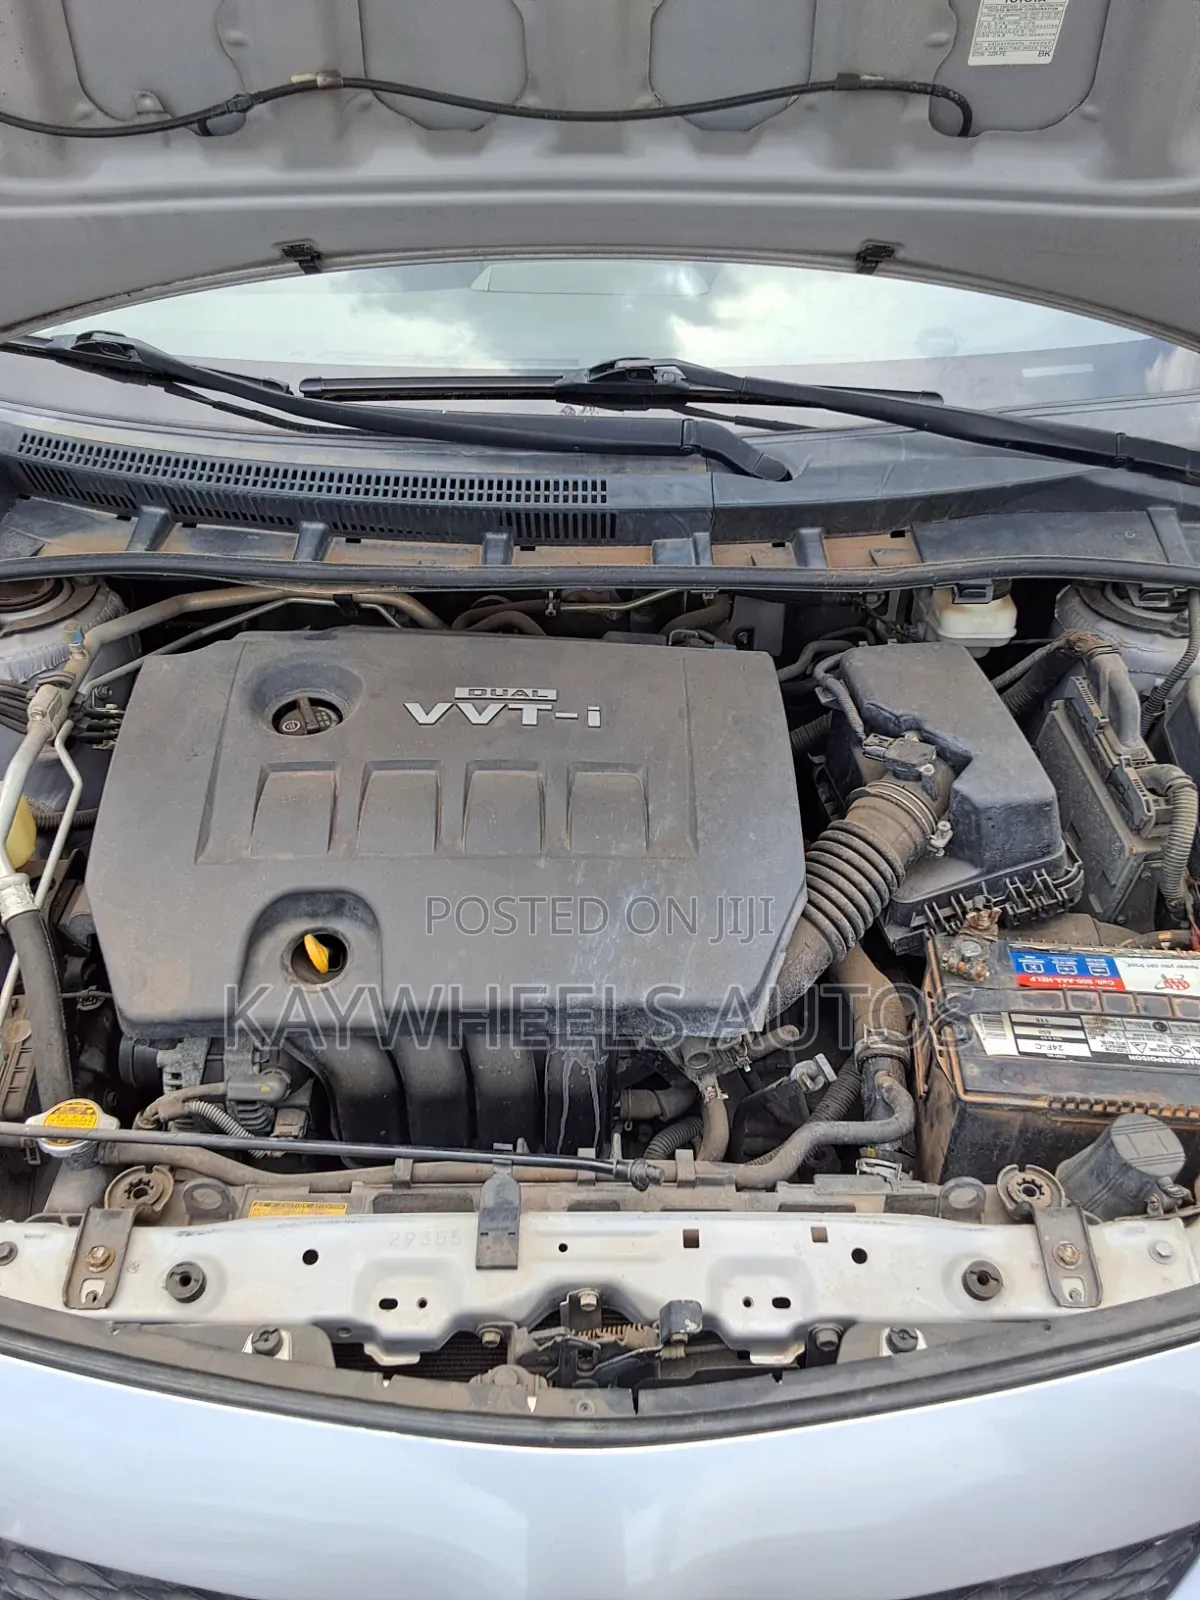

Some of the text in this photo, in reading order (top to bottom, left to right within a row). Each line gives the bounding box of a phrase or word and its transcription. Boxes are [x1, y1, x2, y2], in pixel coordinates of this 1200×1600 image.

[468, 688, 549, 698] DUAL
[403, 702, 601, 728] VVT-i
[1035, 1043, 1064, 1051] 24F-C
